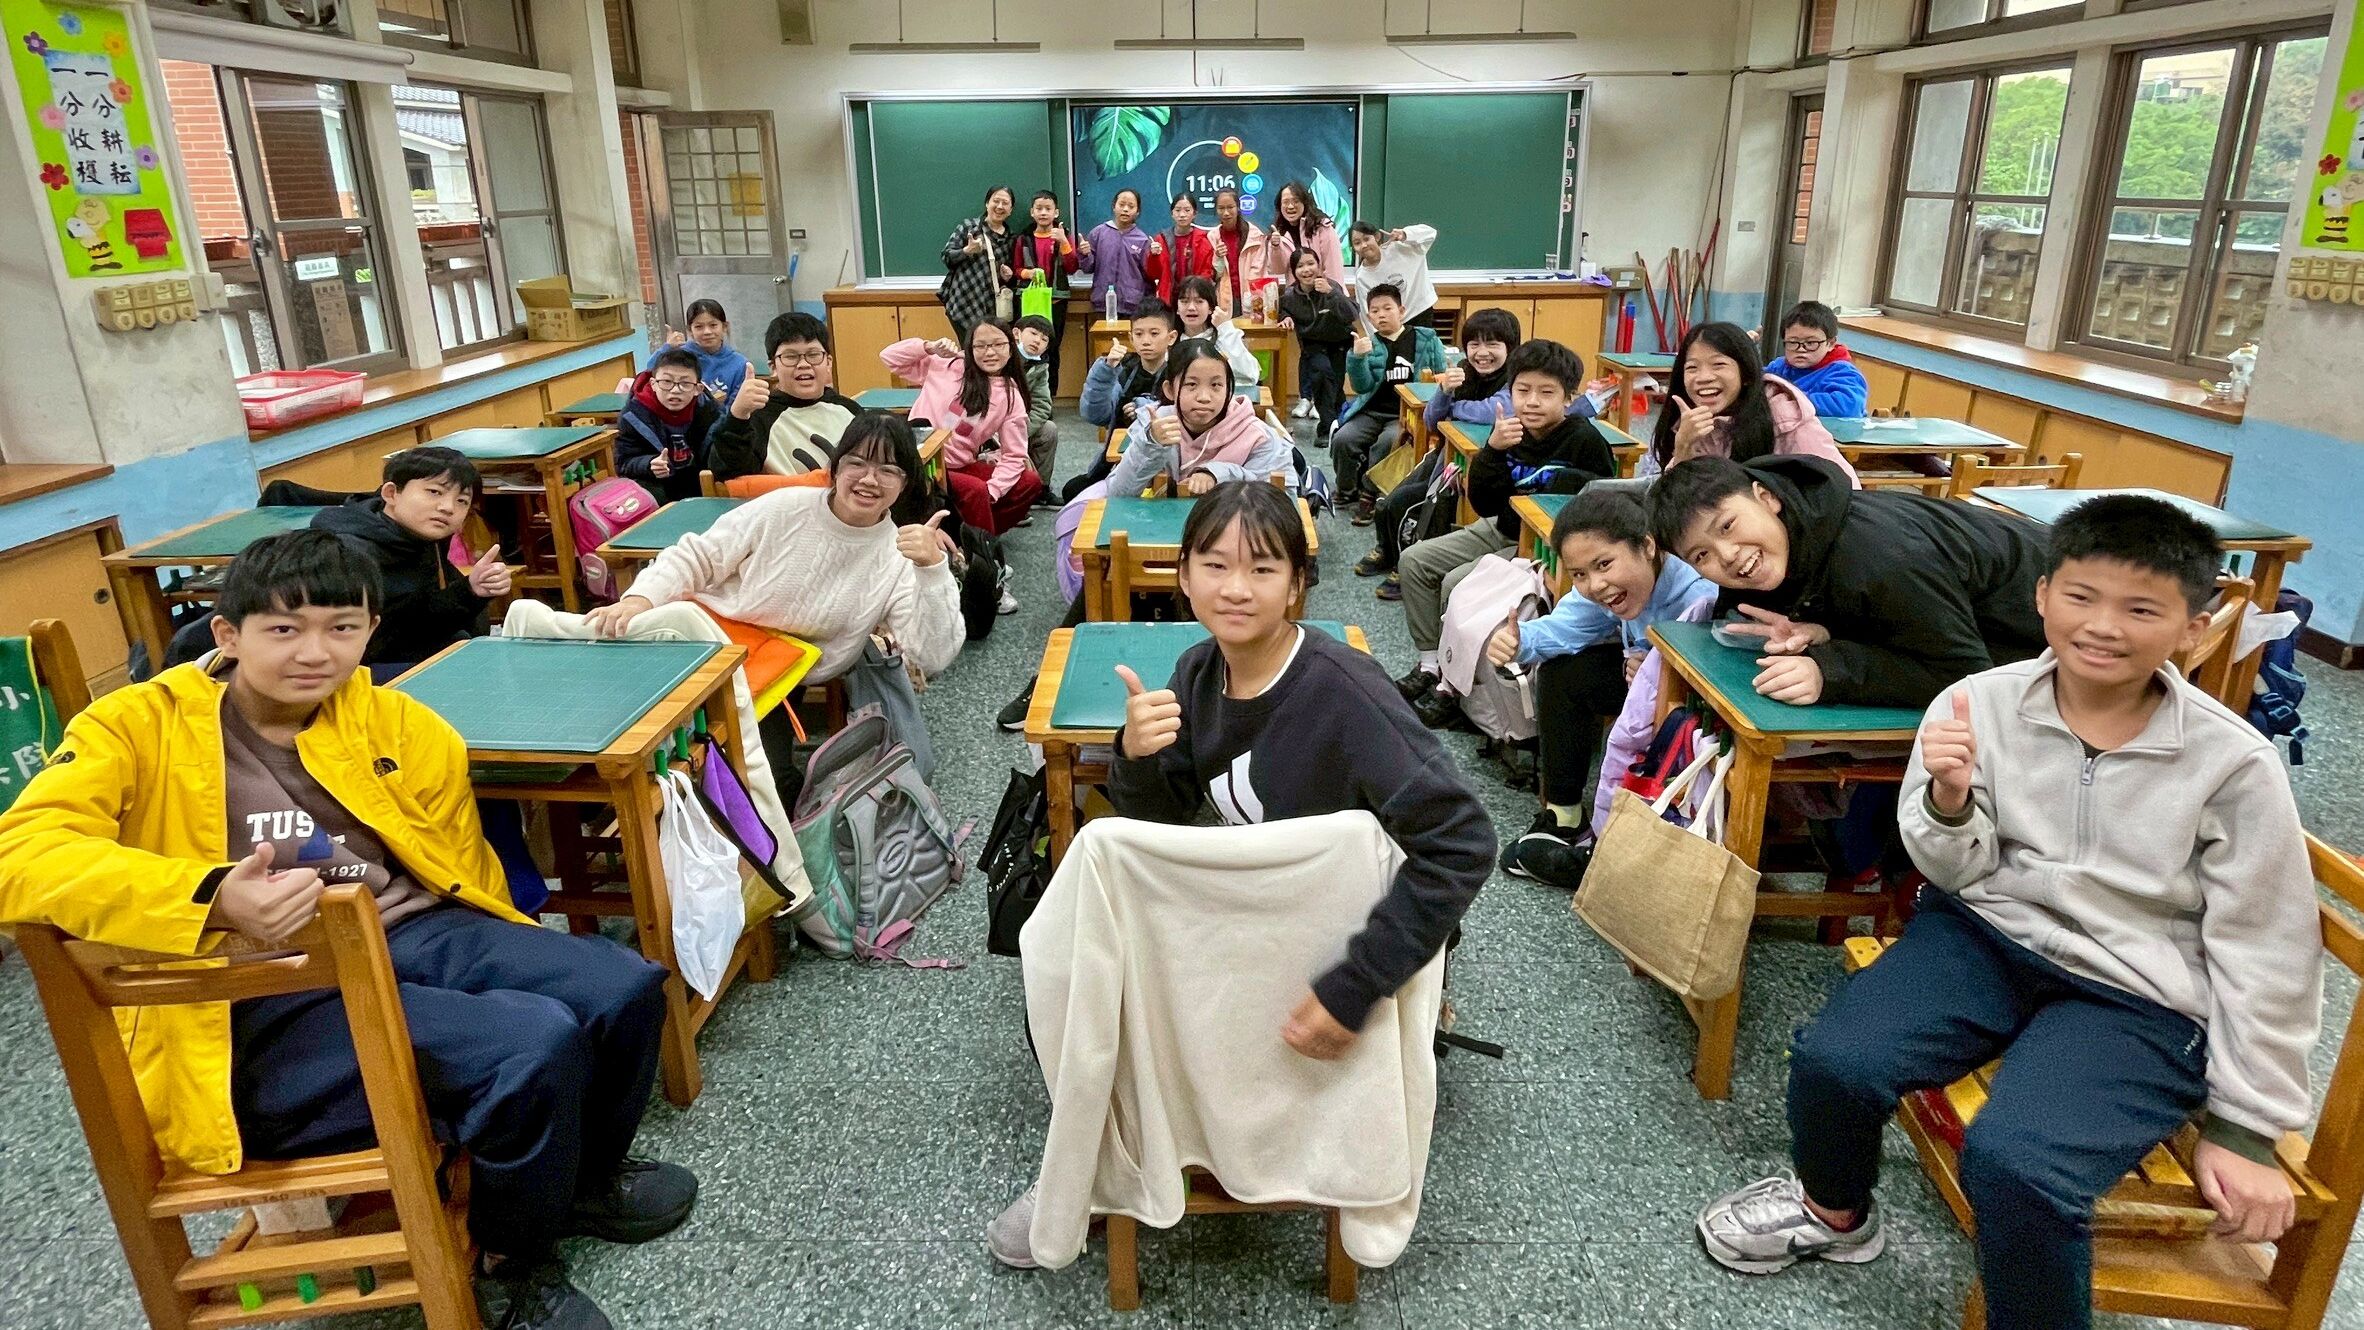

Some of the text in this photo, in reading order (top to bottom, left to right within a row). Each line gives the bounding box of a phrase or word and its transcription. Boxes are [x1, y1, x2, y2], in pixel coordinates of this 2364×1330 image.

[84, 70, 132, 185] 一分耕耘
[1185, 174, 1236, 192] 11:06
[246, 810, 346, 843] TUS
